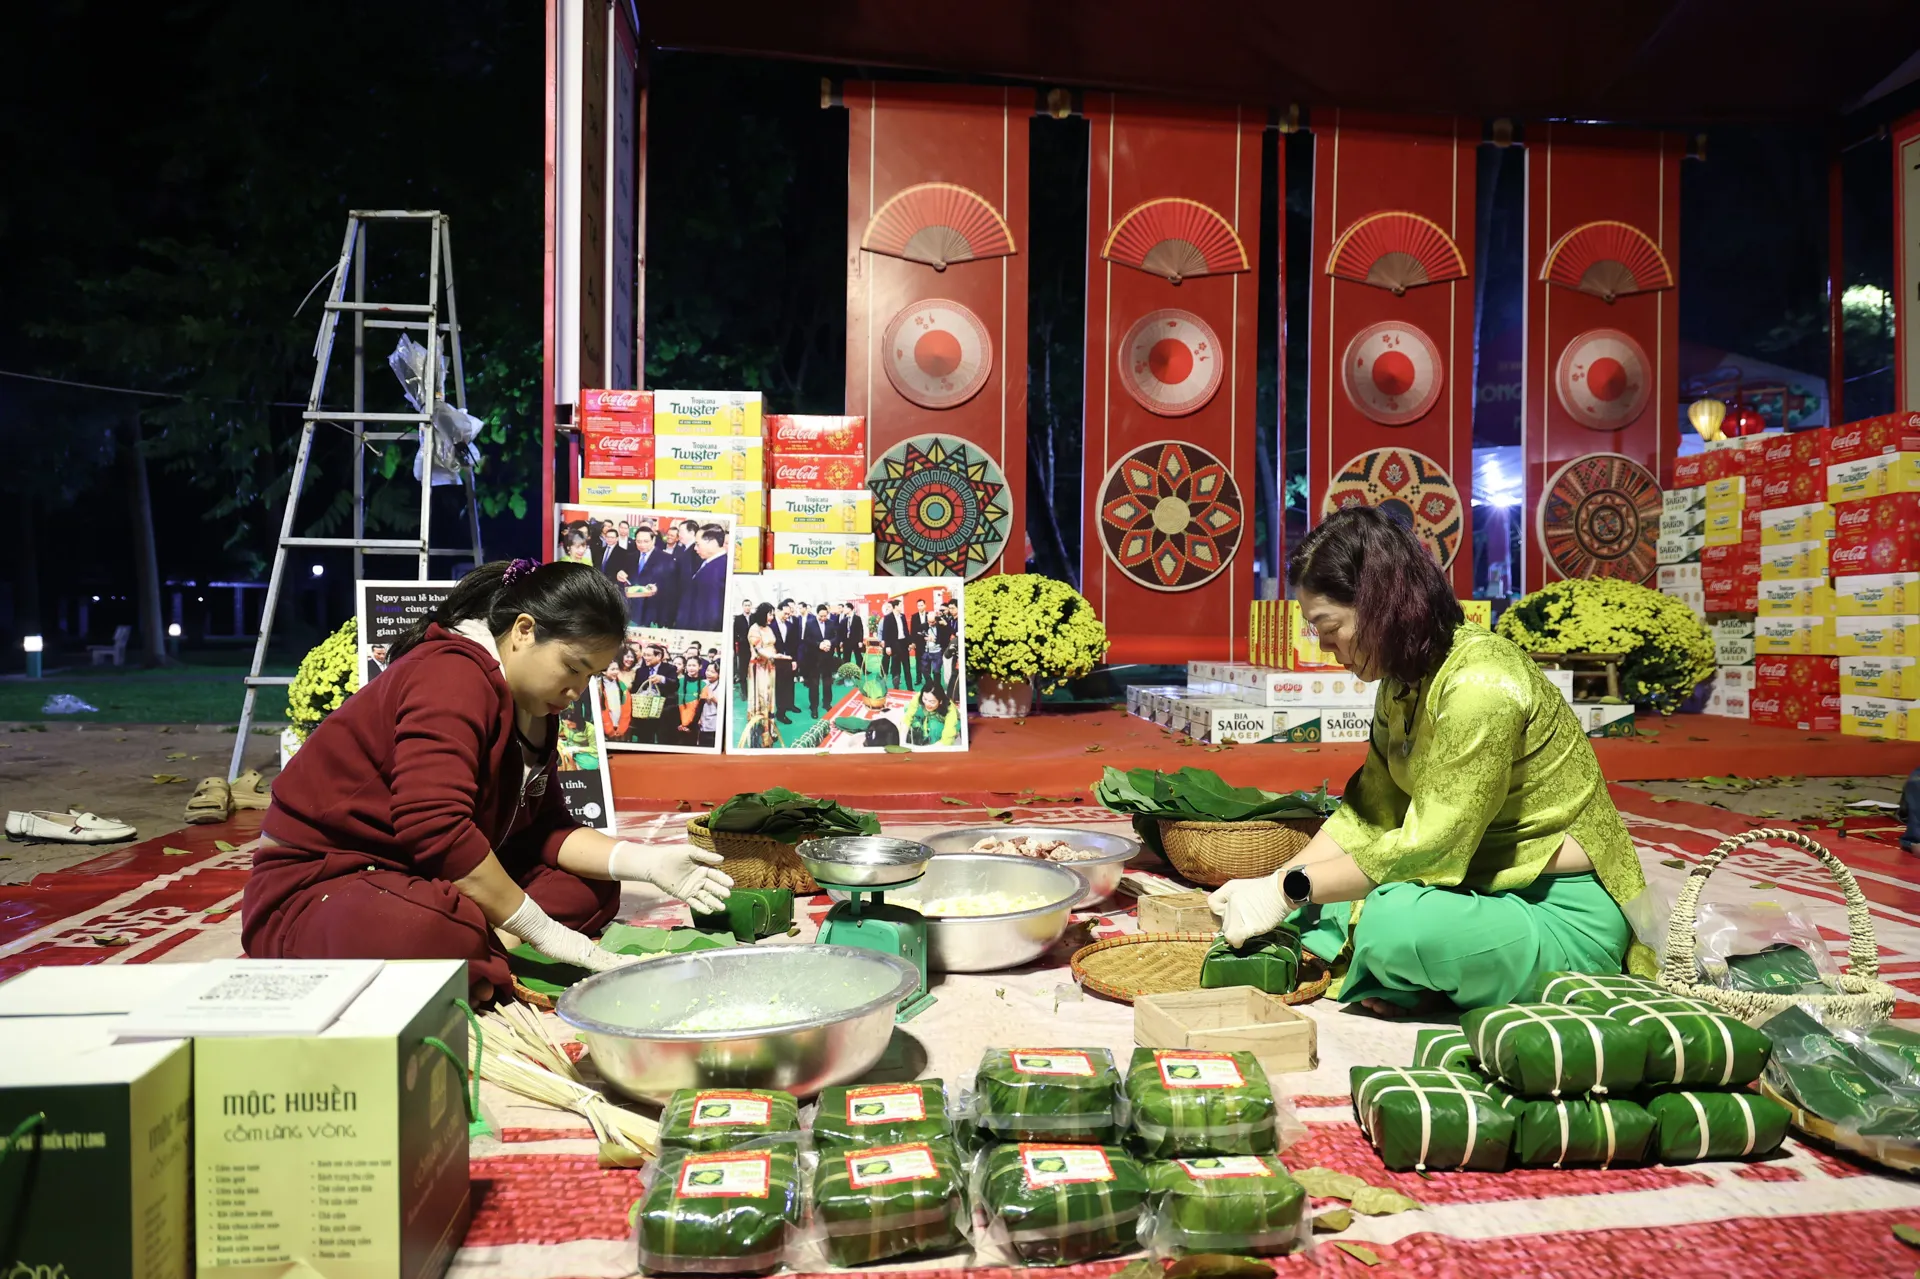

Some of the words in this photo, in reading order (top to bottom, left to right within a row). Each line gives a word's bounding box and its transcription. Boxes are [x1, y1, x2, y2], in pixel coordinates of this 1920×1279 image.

[691, 396, 716, 405] Tropicana
[670, 402, 719, 418] Twister
[692, 442, 717, 450] Tropicana
[671, 447, 721, 463] Twister
[776, 464, 820, 480] Coca-Cola
[691, 487, 716, 495] Tropicana
[670, 492, 720, 508] Twister
[785, 501, 832, 515] Twister
[789, 543, 836, 558] Twister
[375, 594, 399, 603] Ngay
[418, 593, 428, 602] lễ
[405, 605, 428, 614] cùng
[376, 616, 394, 625] tiếp
[376, 628, 397, 637] gian
[1851, 705, 1889, 720] Twister
[1217, 720, 1264, 731] SAIGON
[1327, 719, 1373, 730] SAIGON
[1222, 732, 1260, 740] LAGER
[1331, 730, 1368, 738] LAGER
[223, 1089, 275, 1118] MỘC
[286, 1084, 357, 1113] HUYỀN
[265, 1124, 303, 1141] LÀNG
[306, 1121, 357, 1138] VÒNG
